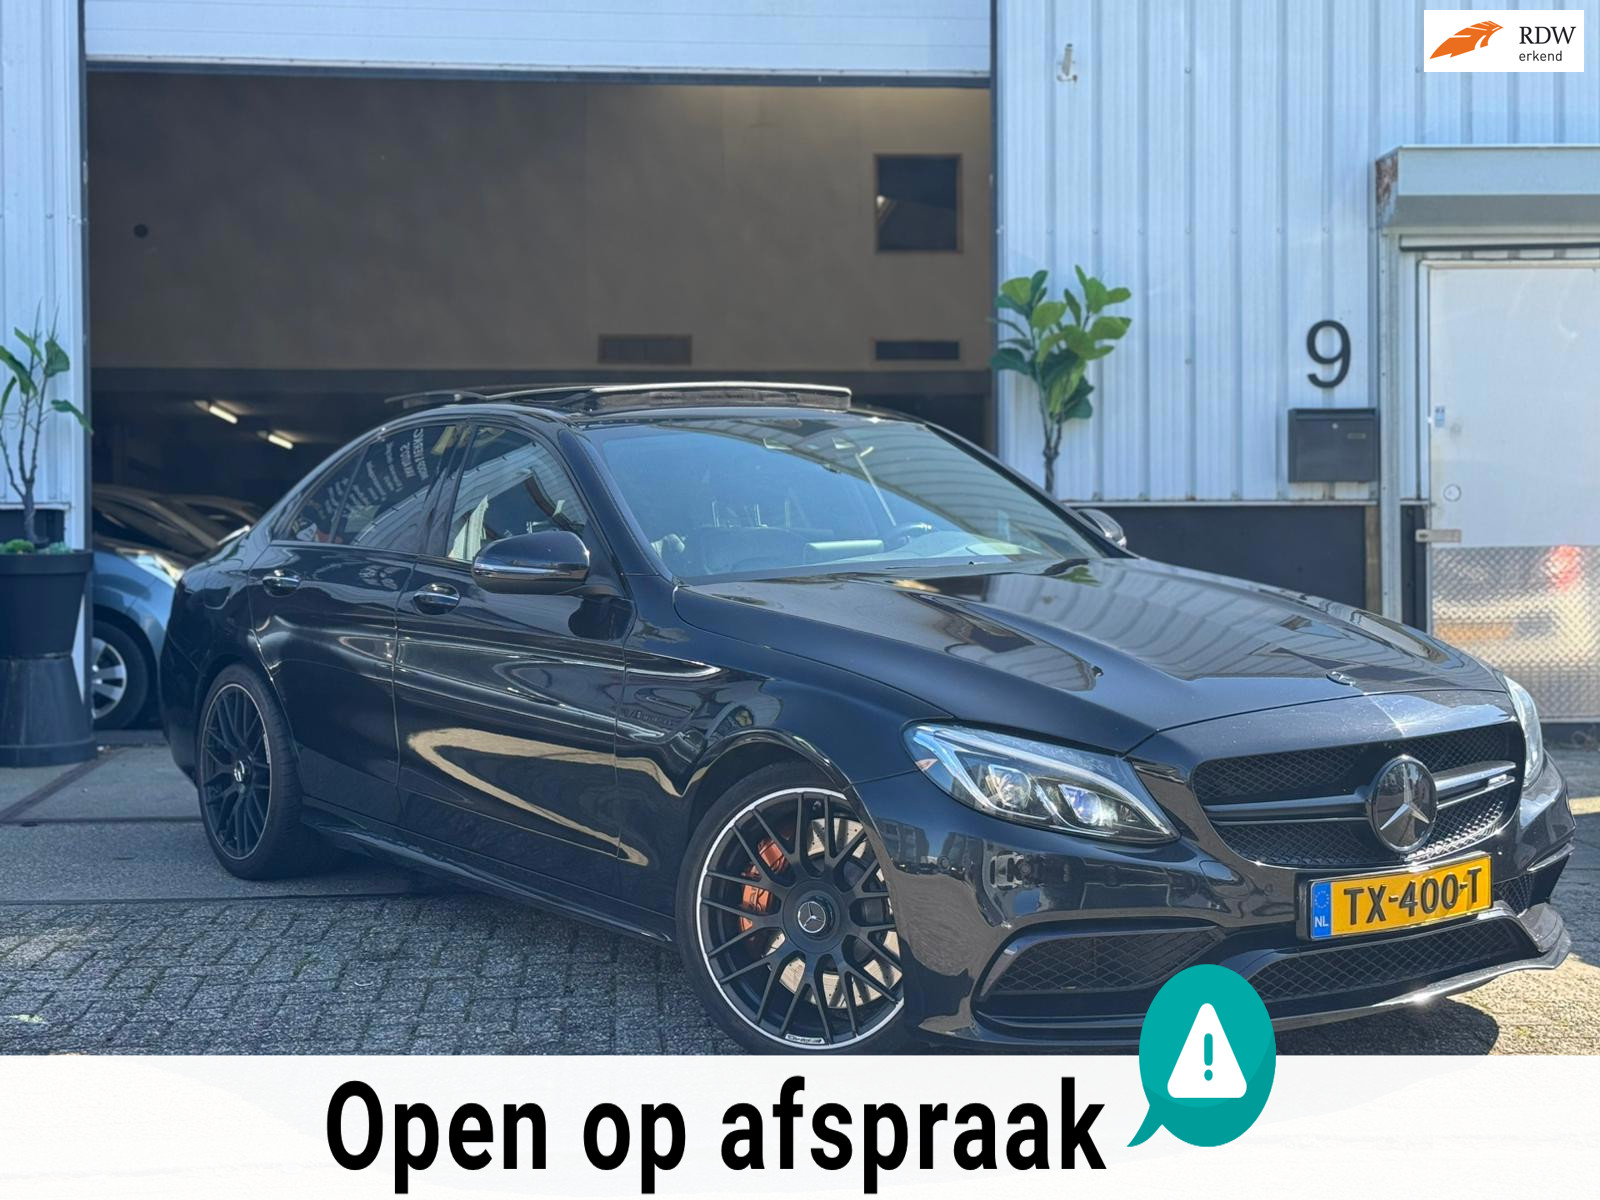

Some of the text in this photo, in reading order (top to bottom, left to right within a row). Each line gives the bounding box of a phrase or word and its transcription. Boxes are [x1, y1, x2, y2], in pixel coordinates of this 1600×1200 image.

[1305, 319, 1352, 391] 9
[1314, 915, 1329, 928] NL
[1343, 867, 1483, 926] TX-400-T
